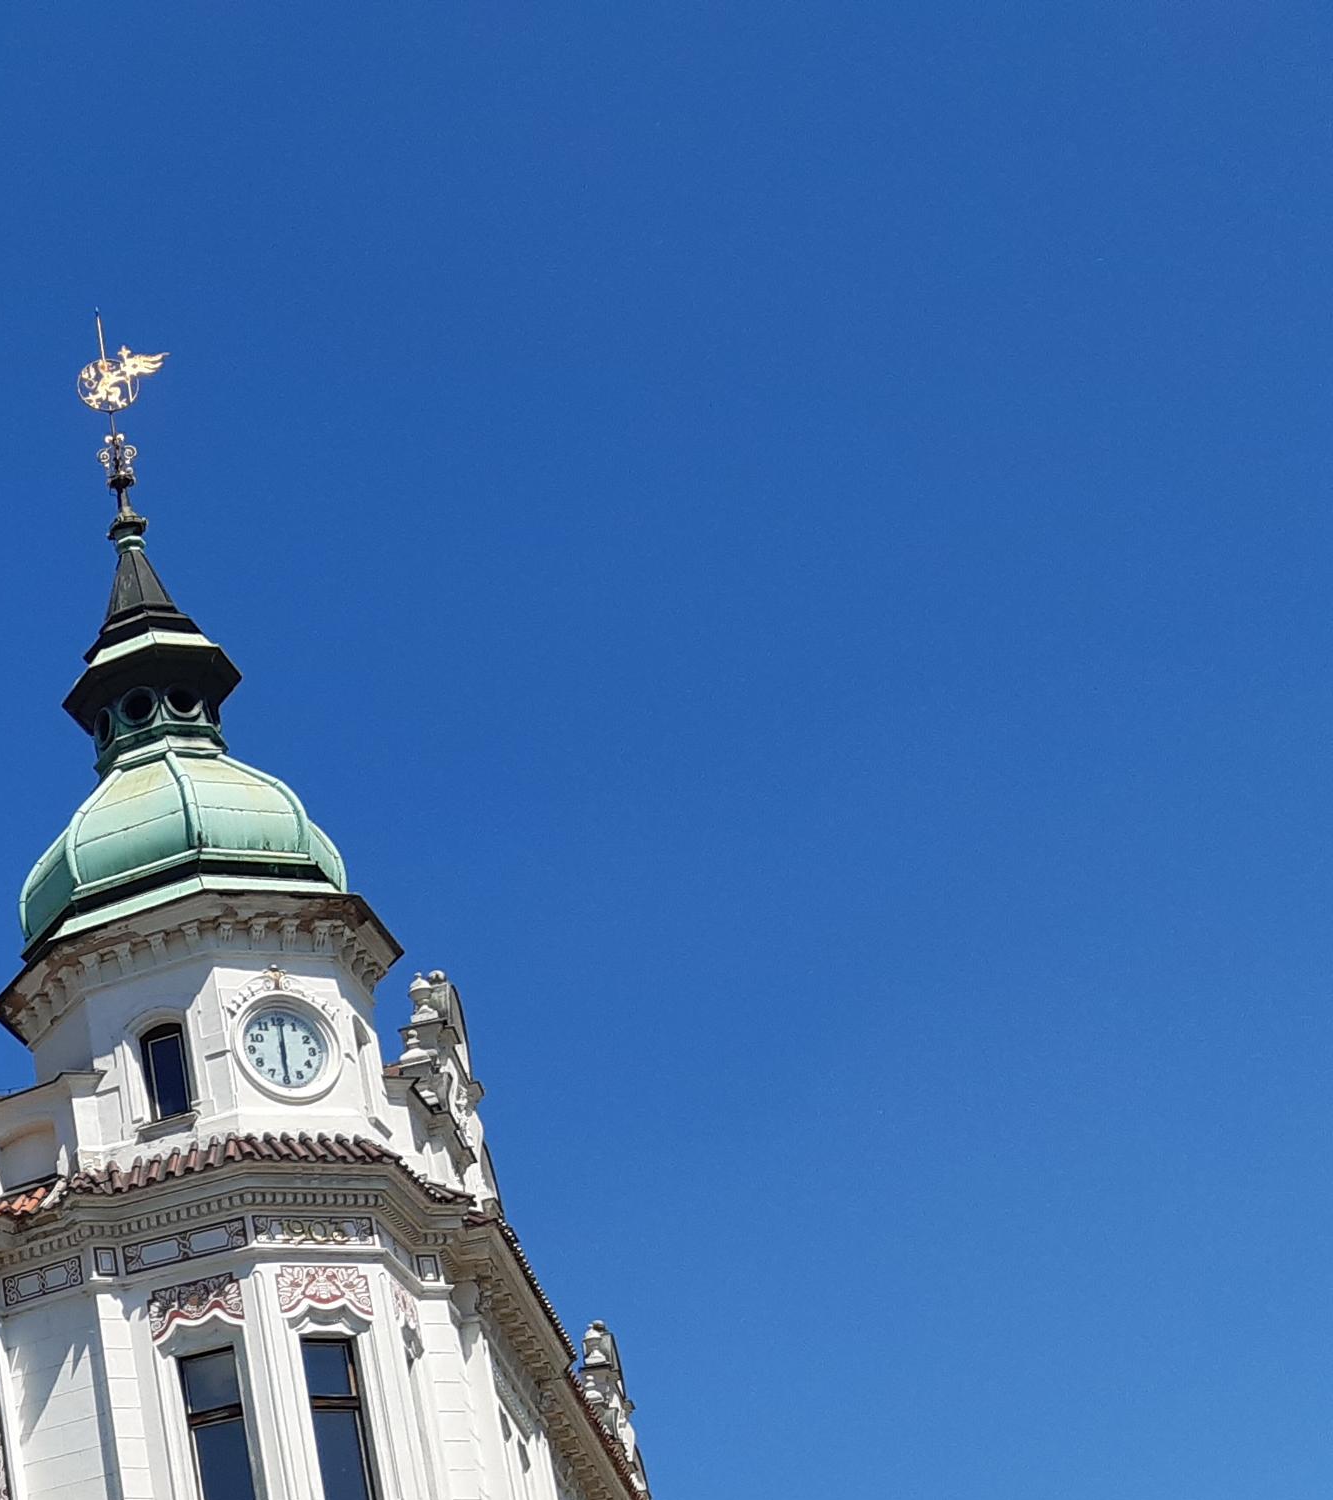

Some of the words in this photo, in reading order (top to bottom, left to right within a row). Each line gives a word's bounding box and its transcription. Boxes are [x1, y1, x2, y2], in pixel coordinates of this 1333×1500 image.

[258, 1021, 269, 1031] 11
[270, 1017, 285, 1027] 12
[290, 1022, 297, 1032] 1
[249, 1033, 264, 1043] 10
[302, 1035, 311, 1044] 2
[248, 1045, 256, 1054] 9
[308, 1047, 316, 1057] 3
[255, 1057, 264, 1067] 8
[304, 1059, 312, 1069] 4
[268, 1069, 276, 1078] 7
[296, 1070, 304, 1080] 5
[283, 1075, 291, 1085] 6
